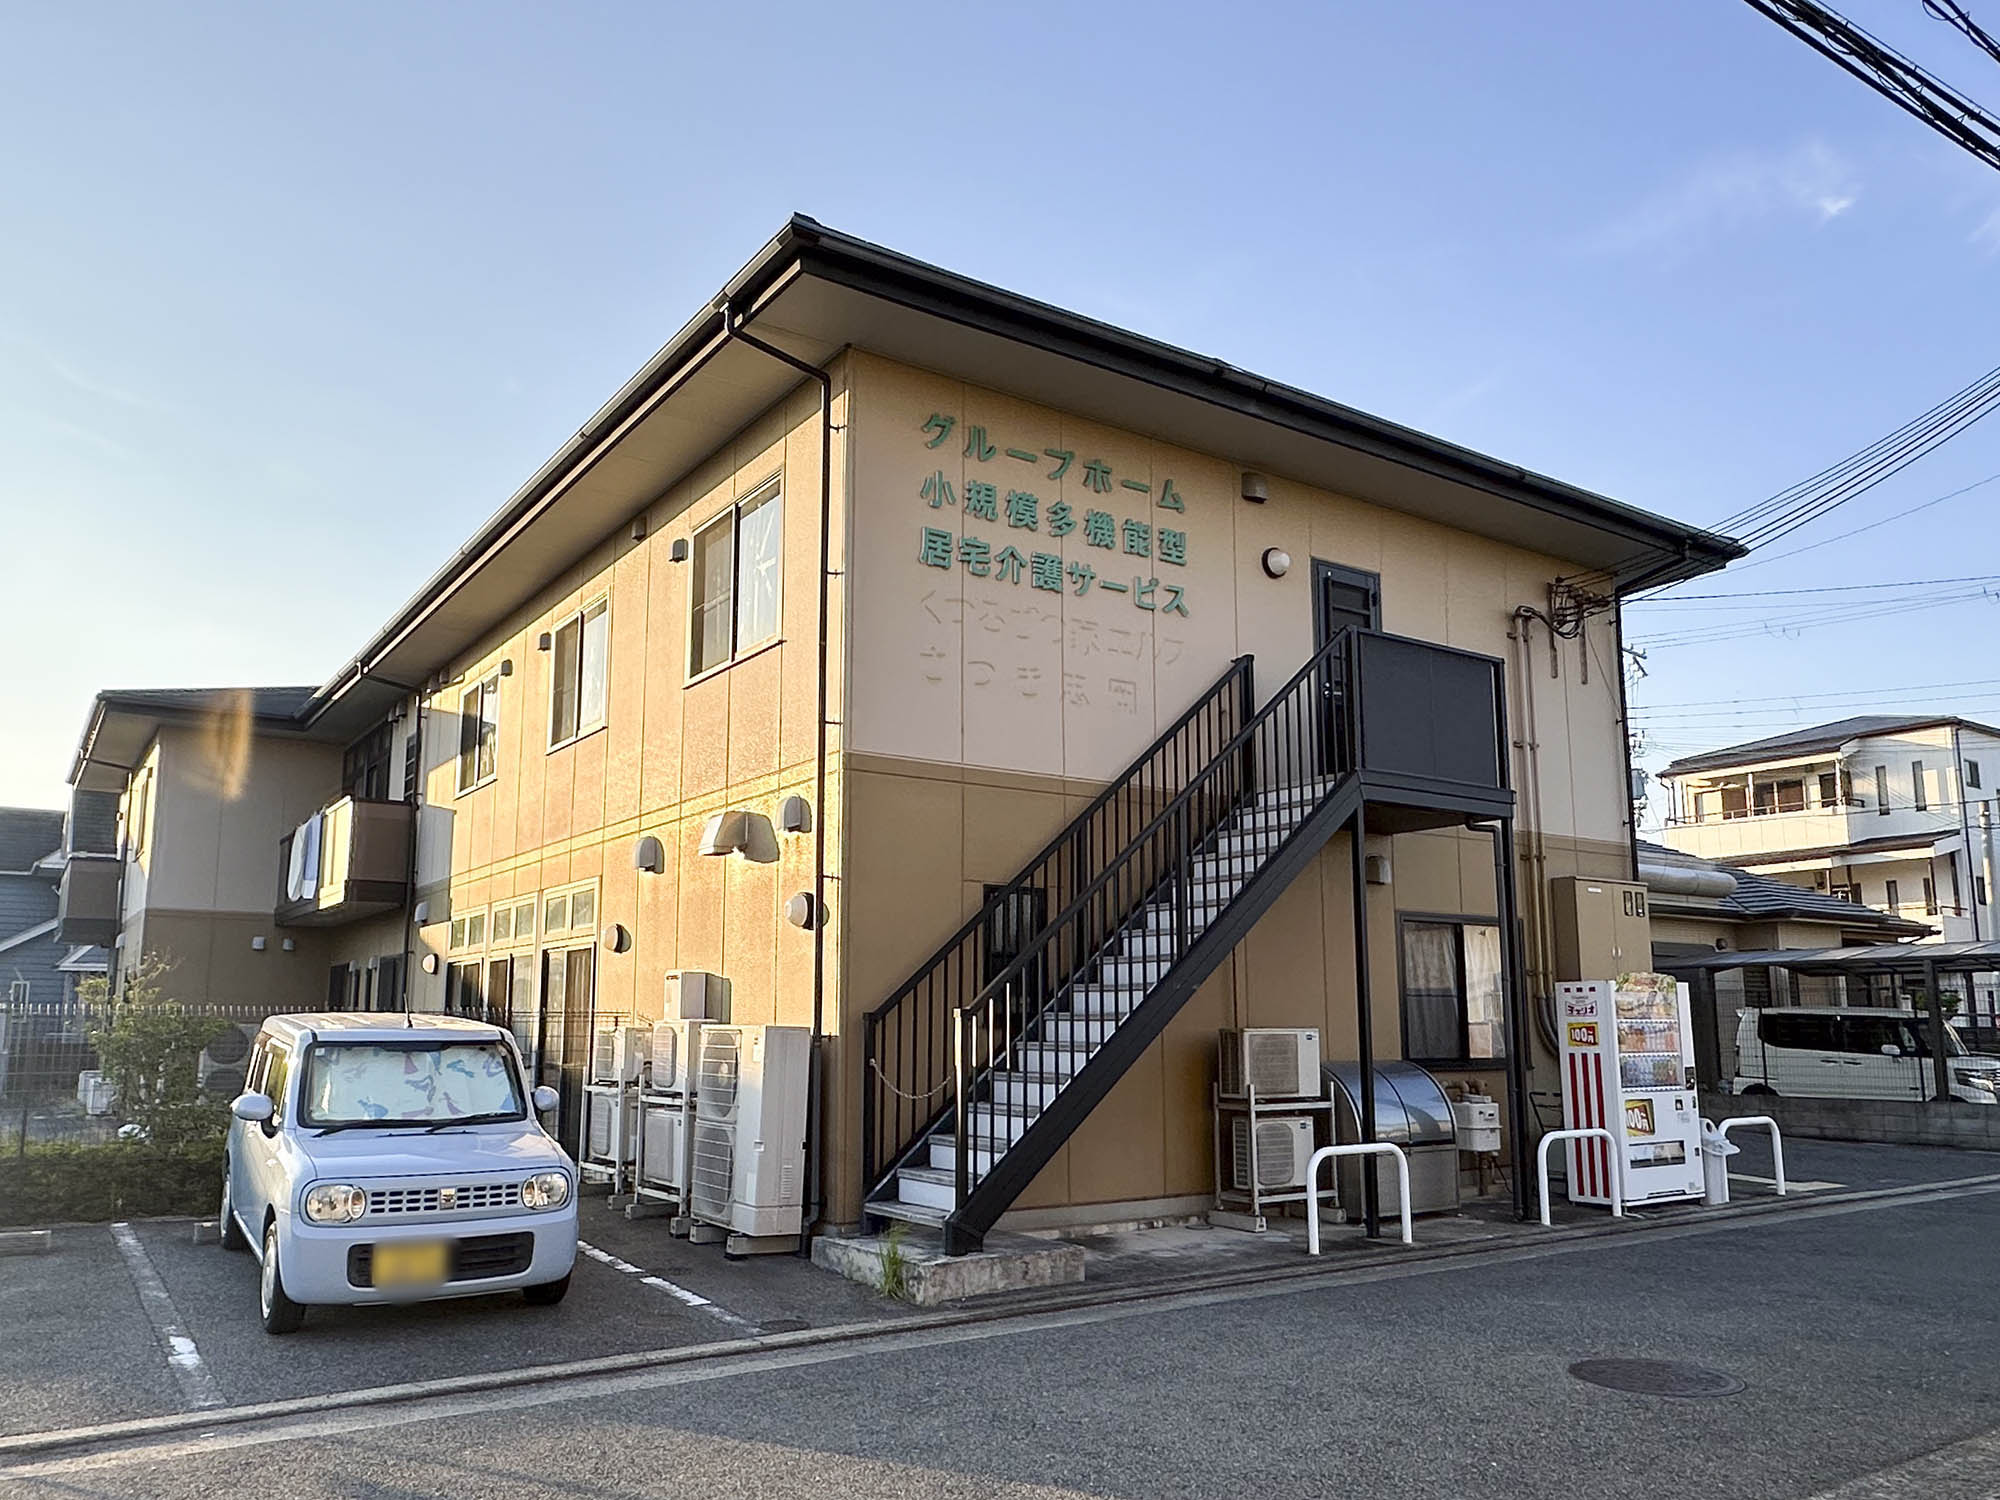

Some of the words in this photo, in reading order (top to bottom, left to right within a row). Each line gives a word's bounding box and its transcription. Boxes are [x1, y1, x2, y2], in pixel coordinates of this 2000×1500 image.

[919, 470, 1188, 567] 小規模多機能型
[918, 525, 1190, 618] 居宅介護サービス
